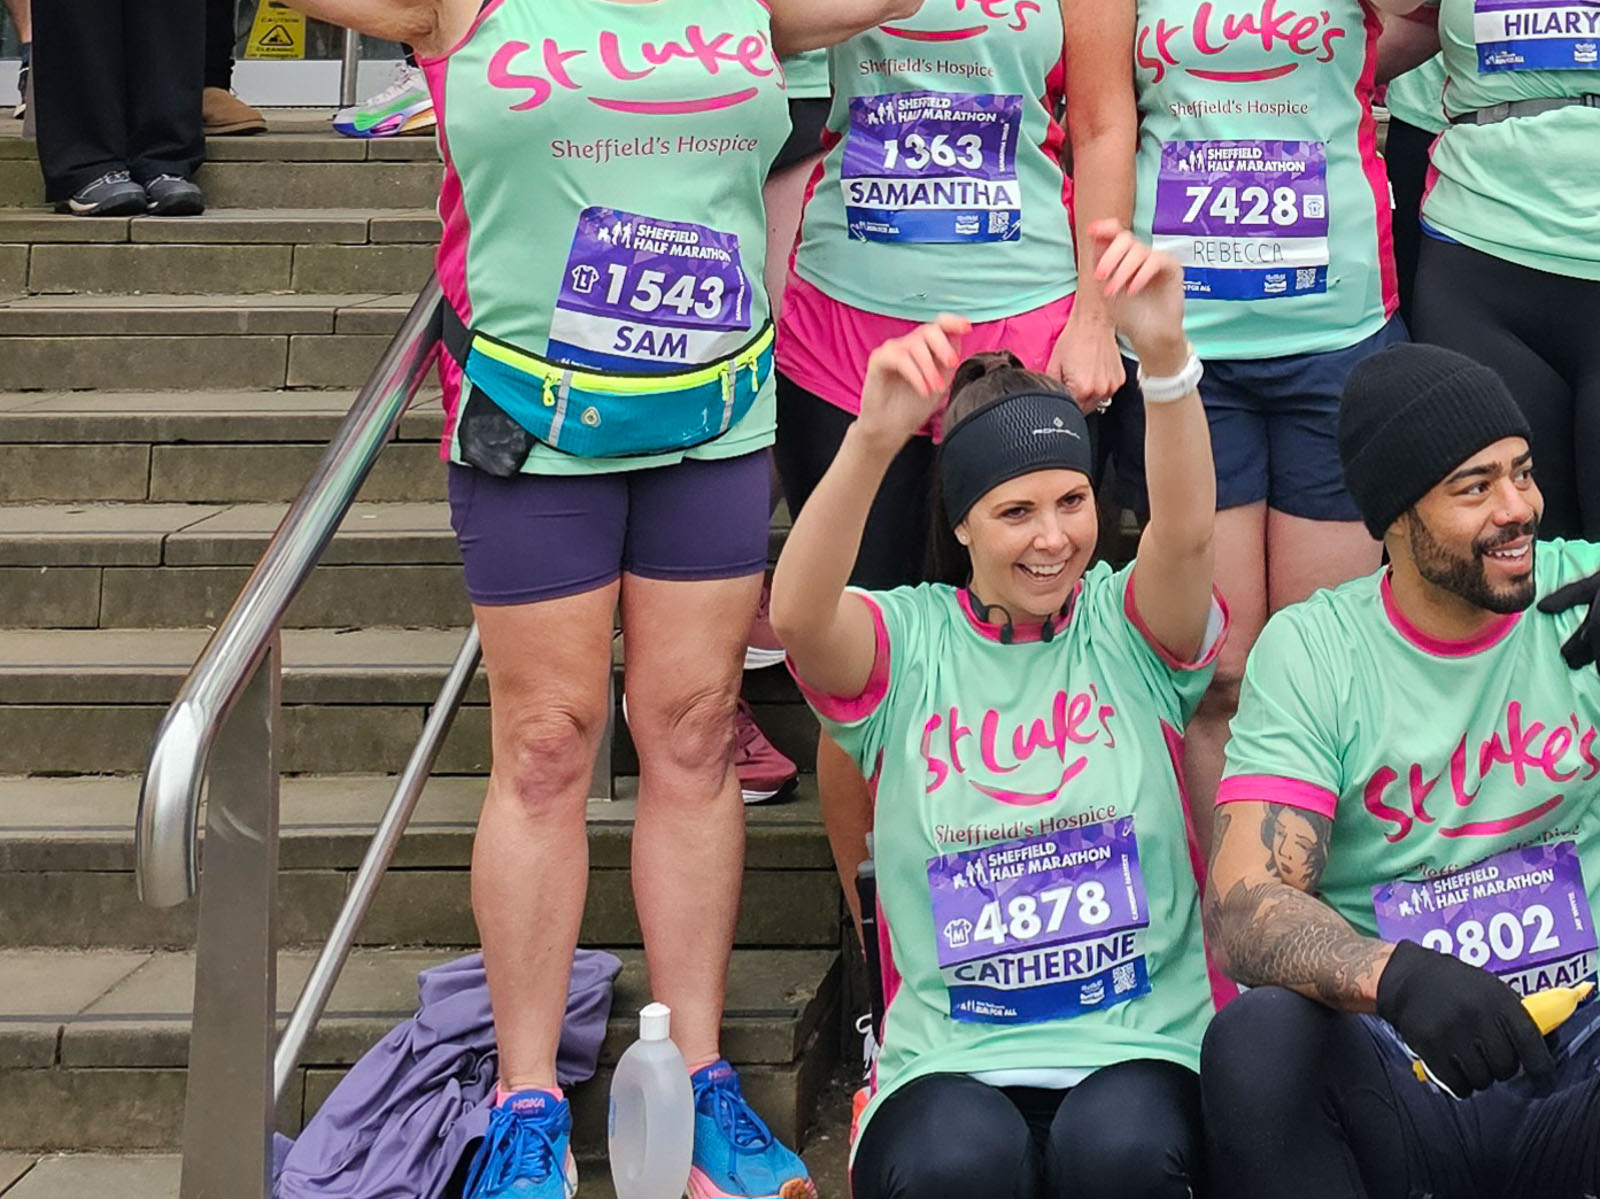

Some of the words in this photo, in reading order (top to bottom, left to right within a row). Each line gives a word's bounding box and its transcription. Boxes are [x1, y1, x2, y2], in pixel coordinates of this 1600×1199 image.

[1136, 18, 1185, 85] St
[486, 38, 588, 112] St
[599, 24, 787, 91] Luke's
[937, 59, 994, 79] Hospice
[897, 97, 952, 111] SHEFFIELD
[922, 108, 998, 123] MARATHON
[1169, 99, 1243, 119] Sheffield's
[1247, 99, 1309, 117] Hospice
[551, 135, 670, 164] Sheffield's
[676, 133, 759, 157] Hospice
[883, 132, 984, 171] 1363
[1207, 147, 1263, 161] SHEFFIELD
[1207, 160, 1236, 173] HALF
[1237, 159, 1306, 173] MARATHON
[849, 181, 1014, 206] SAMANTHA
[1182, 185, 1299, 227] 7428
[636, 223, 699, 244] SHEFFIELD
[633, 237, 669, 255] HALF
[669, 243, 732, 263] MARATHON
[1193, 240, 1284, 264] REBECCA
[605, 262, 726, 320] 1543
[613, 325, 689, 359] SAM
[919, 706, 973, 795] St
[1363, 762, 1442, 844] St
[1450, 700, 1600, 808] Luke's
[934, 820, 1035, 847] Sheffield's
[1039, 804, 1118, 834] Hospice
[988, 841, 1057, 868] SHEFFIELD
[989, 863, 1026, 883] HALF
[1028, 844, 1112, 875] MARATHON
[1432, 865, 1500, 895] SHEFFIELD
[1435, 889, 1469, 910] HALF
[1472, 868, 1554, 900] MARATHON
[973, 879, 1112, 945] 4878
[953, 931, 1137, 986] CATHERINE
[1507, 953, 1590, 998] CLAAT!
[511, 1097, 546, 1110] HOKA
